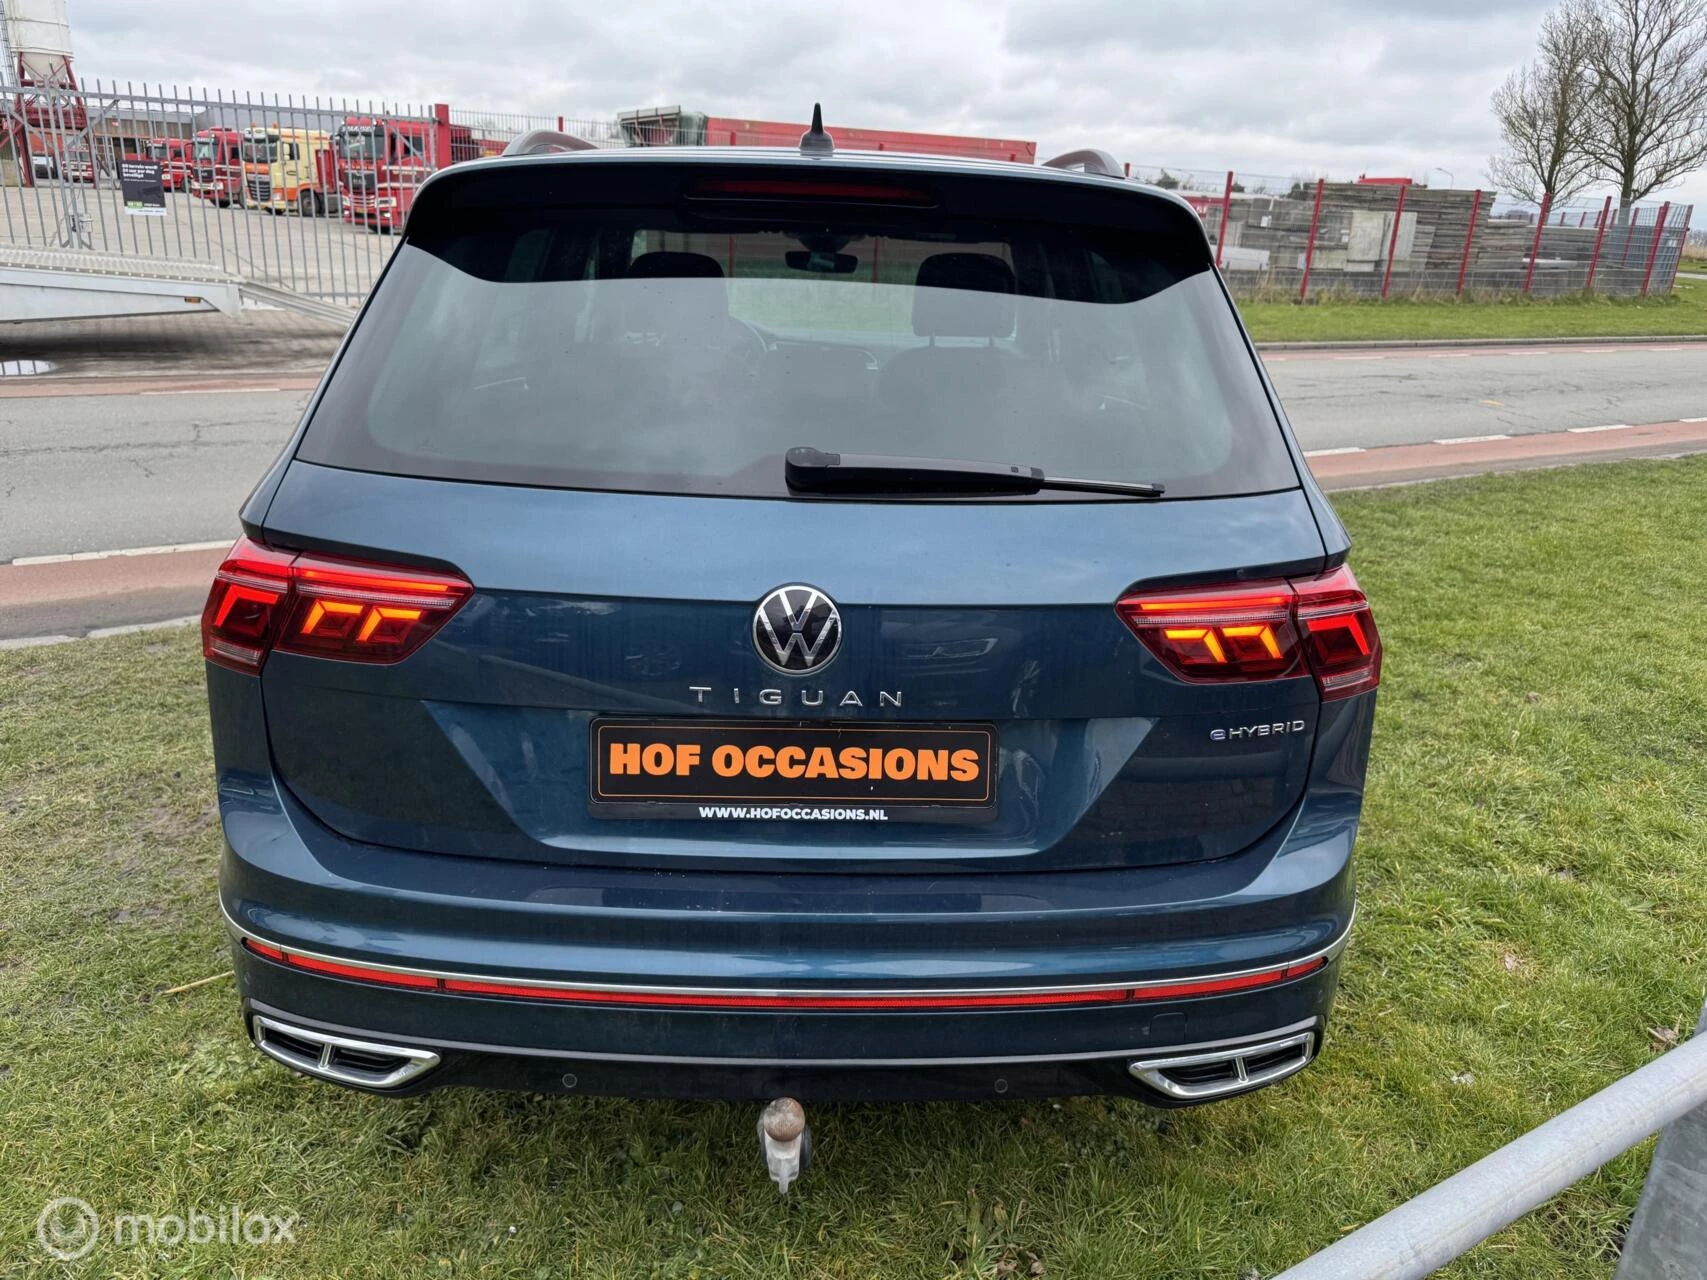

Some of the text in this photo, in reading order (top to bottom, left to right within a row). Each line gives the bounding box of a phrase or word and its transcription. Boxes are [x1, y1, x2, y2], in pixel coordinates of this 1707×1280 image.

[689, 686, 903, 707] TIGUAN
[609, 743, 980, 782] HOF OCCASIONS
[698, 806, 888, 821] WWW.HOFOCCASIONS.NL
